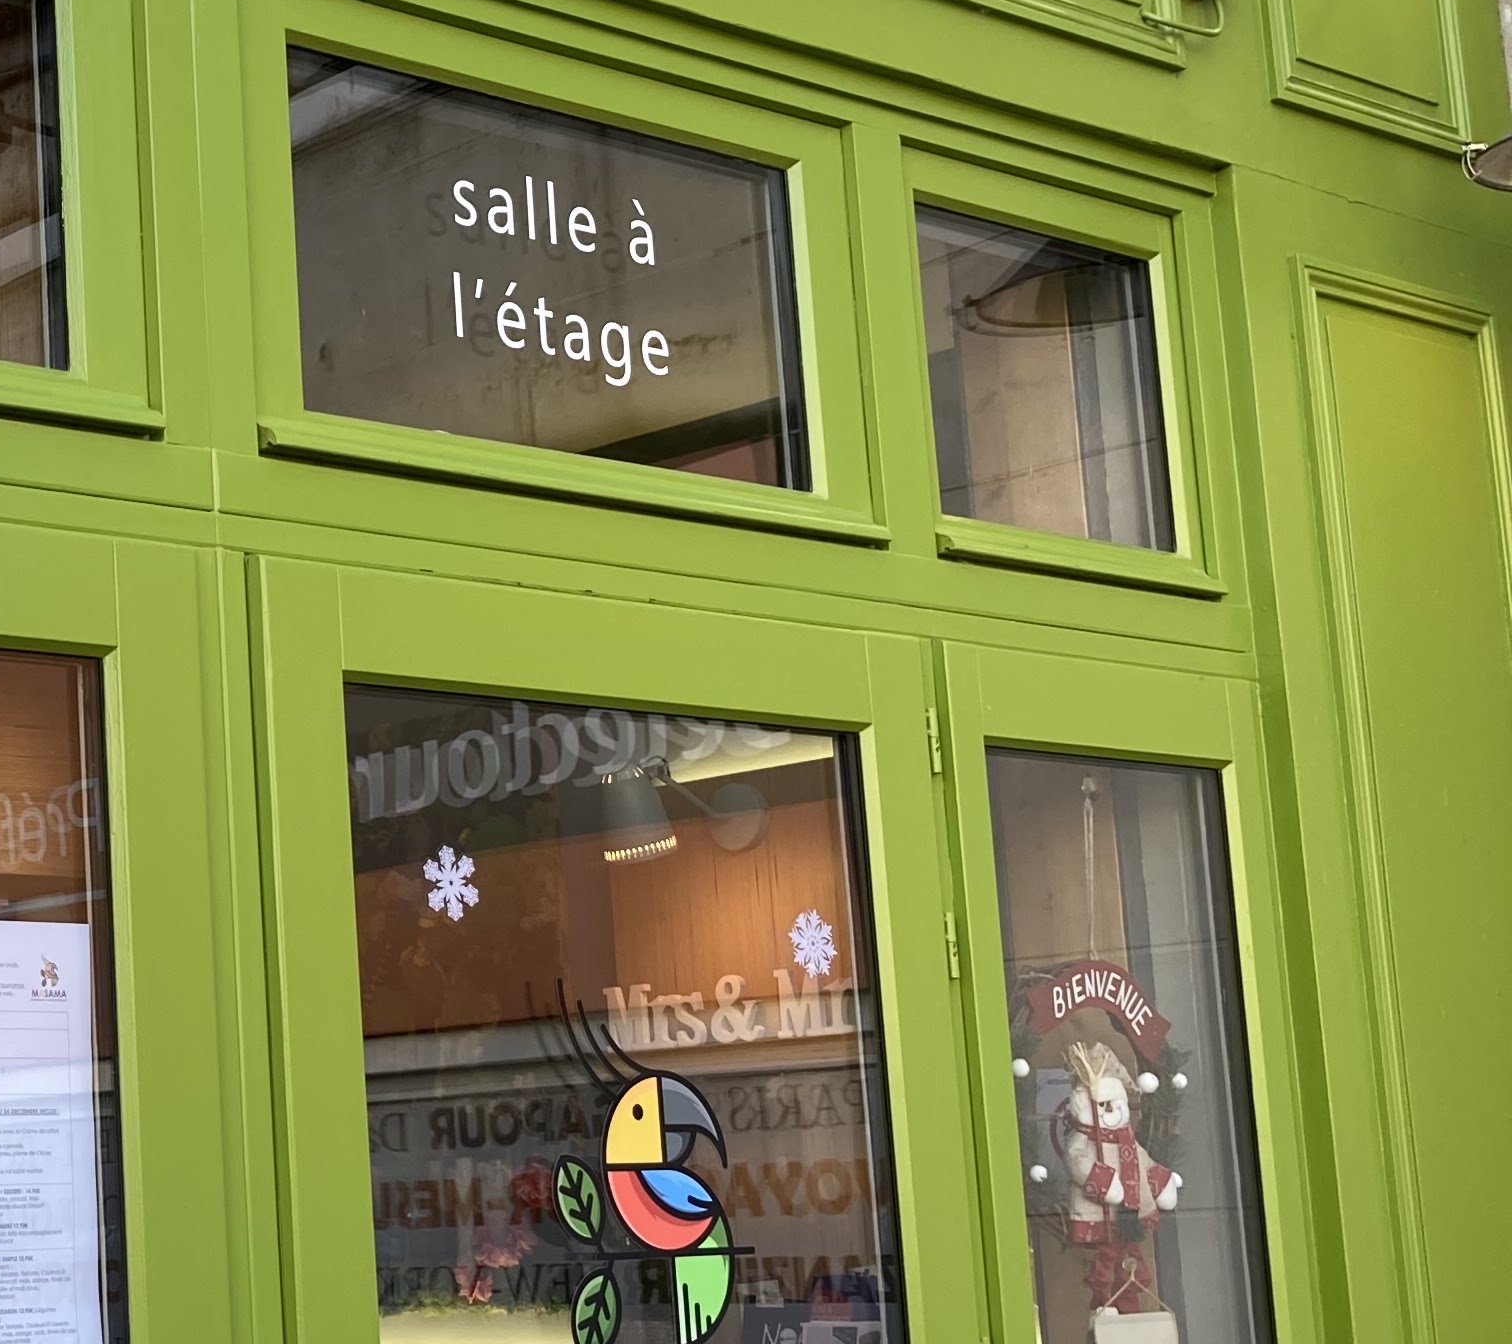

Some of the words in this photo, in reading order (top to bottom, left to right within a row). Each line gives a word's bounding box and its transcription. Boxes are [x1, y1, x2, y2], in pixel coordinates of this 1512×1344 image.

[452, 175, 597, 253] salle
[628, 198, 657, 266] à
[451, 271, 671, 387] l'étage
[603, 983, 705, 1052] Mrs
[711, 974, 765, 1044] &
